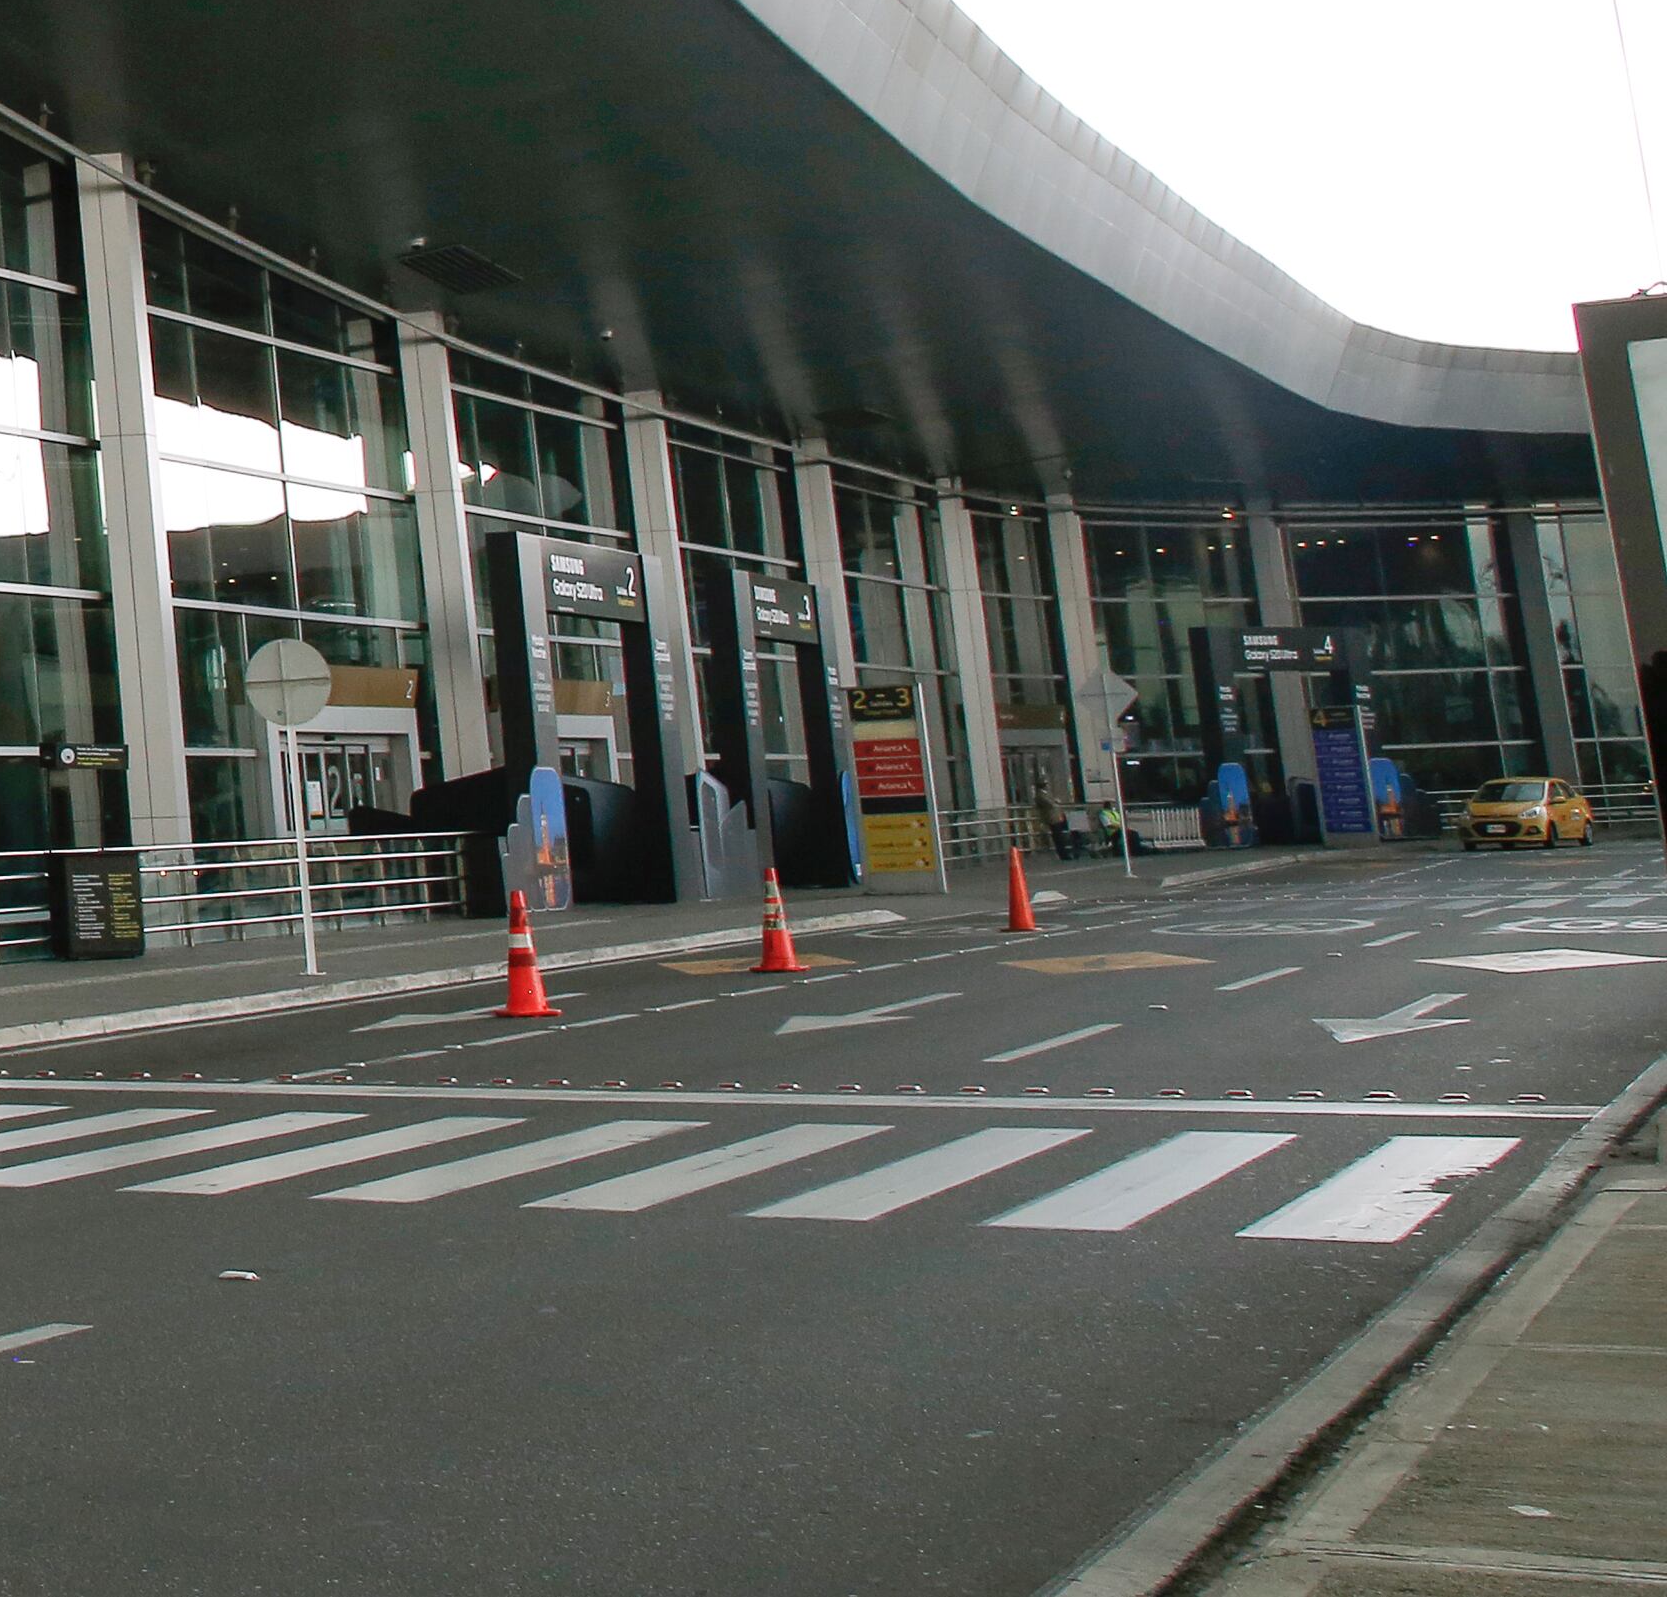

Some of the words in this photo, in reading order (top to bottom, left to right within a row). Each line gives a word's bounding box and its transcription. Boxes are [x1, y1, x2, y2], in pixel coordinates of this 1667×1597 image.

[626, 566, 637, 598] 2
[1323, 635, 1333, 654] 4
[853, 690, 867, 709] 2
[895, 687, 910, 707] 3
[328, 765, 345, 817] 2
